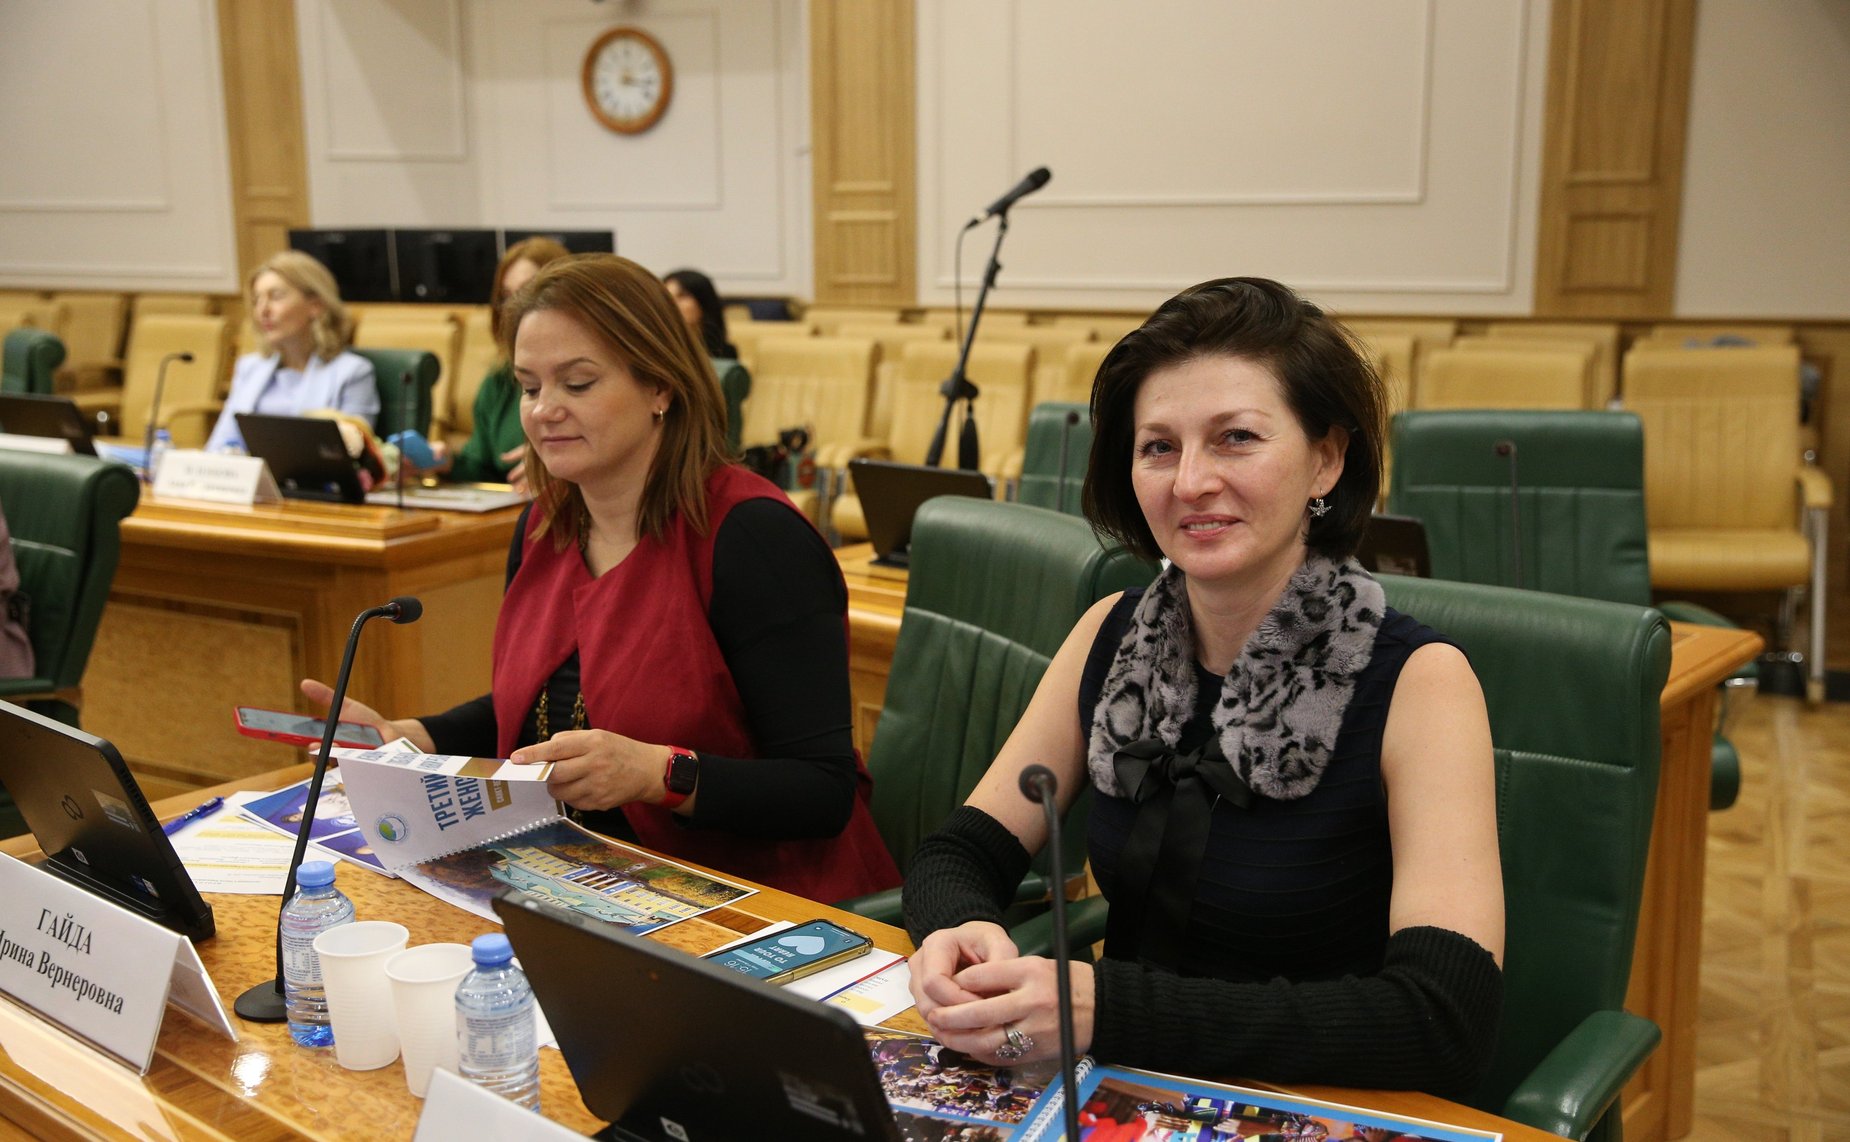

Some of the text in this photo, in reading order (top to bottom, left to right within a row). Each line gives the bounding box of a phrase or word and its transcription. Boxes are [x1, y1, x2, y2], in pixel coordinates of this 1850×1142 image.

[420, 773, 460, 831] ТРЕТИЙ
[36, 907, 93, 956] ГАЙДА
[36, 950, 125, 1015] Вернеровна
